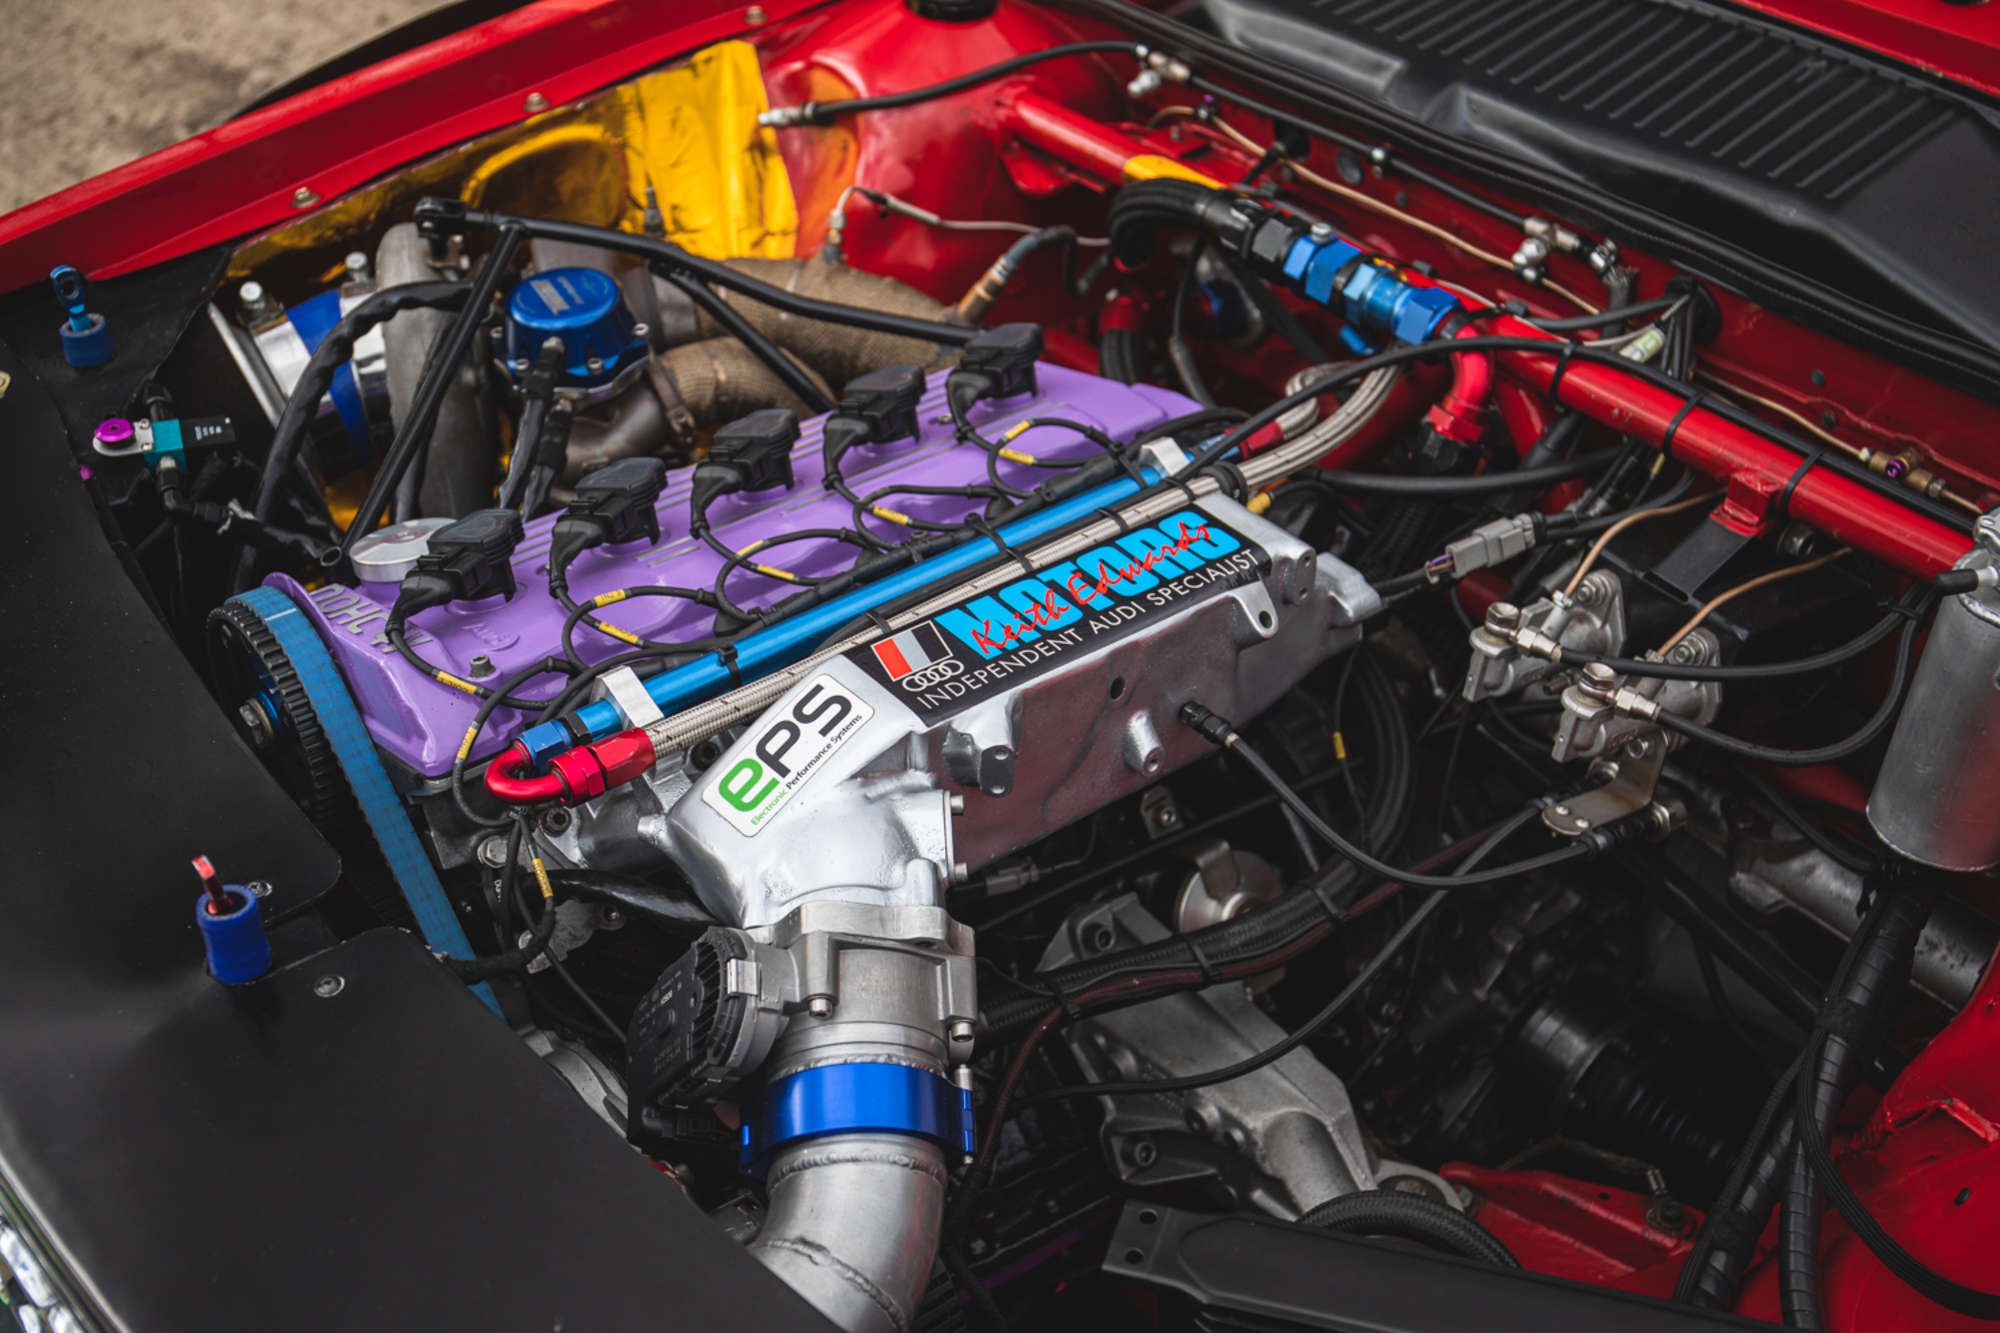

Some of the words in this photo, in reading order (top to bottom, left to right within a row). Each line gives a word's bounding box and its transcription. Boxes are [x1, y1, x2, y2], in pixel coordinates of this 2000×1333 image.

[916, 628, 1083, 710] INDEPENDENT
[1089, 600, 1147, 635] AUDI
[1146, 548, 1260, 606] SPECIALIST
[934, 512, 1240, 660] MOTORS
[972, 589, 1070, 655] Keith
[1066, 521, 1210, 606] Edwards
[750, 788, 788, 826] Electronic
[785, 742, 833, 790] Performance
[830, 714, 863, 744] Systems
